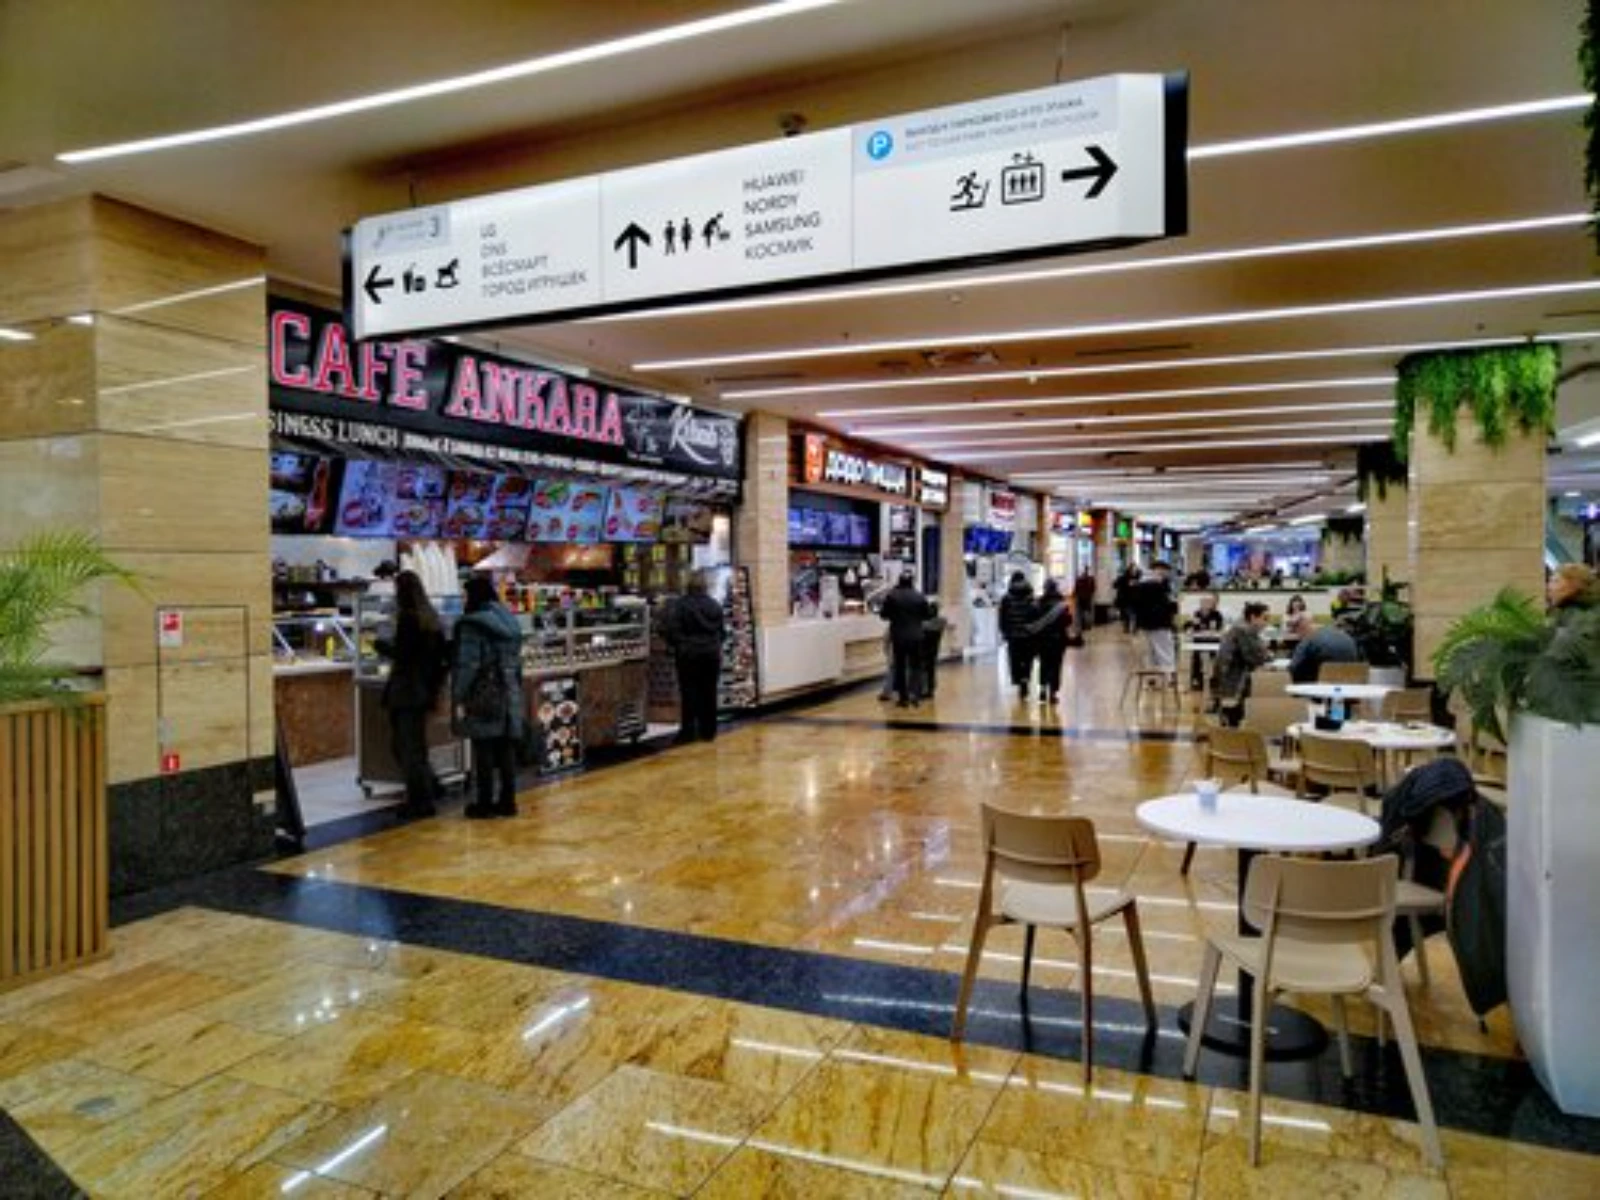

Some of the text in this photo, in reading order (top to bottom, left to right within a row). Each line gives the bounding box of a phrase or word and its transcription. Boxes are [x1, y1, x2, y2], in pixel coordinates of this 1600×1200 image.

[743, 169, 804, 193] HUAWEI
[743, 193, 799, 215] NORDY
[745, 209, 821, 239] SAMSUNG
[745, 237, 814, 260] КОСМИК
[481, 278, 526, 298] ГОРОД
[272, 310, 429, 411] CAFE
[444, 356, 625, 446] ANKARA
[337, 419, 398, 447] LUNCH
